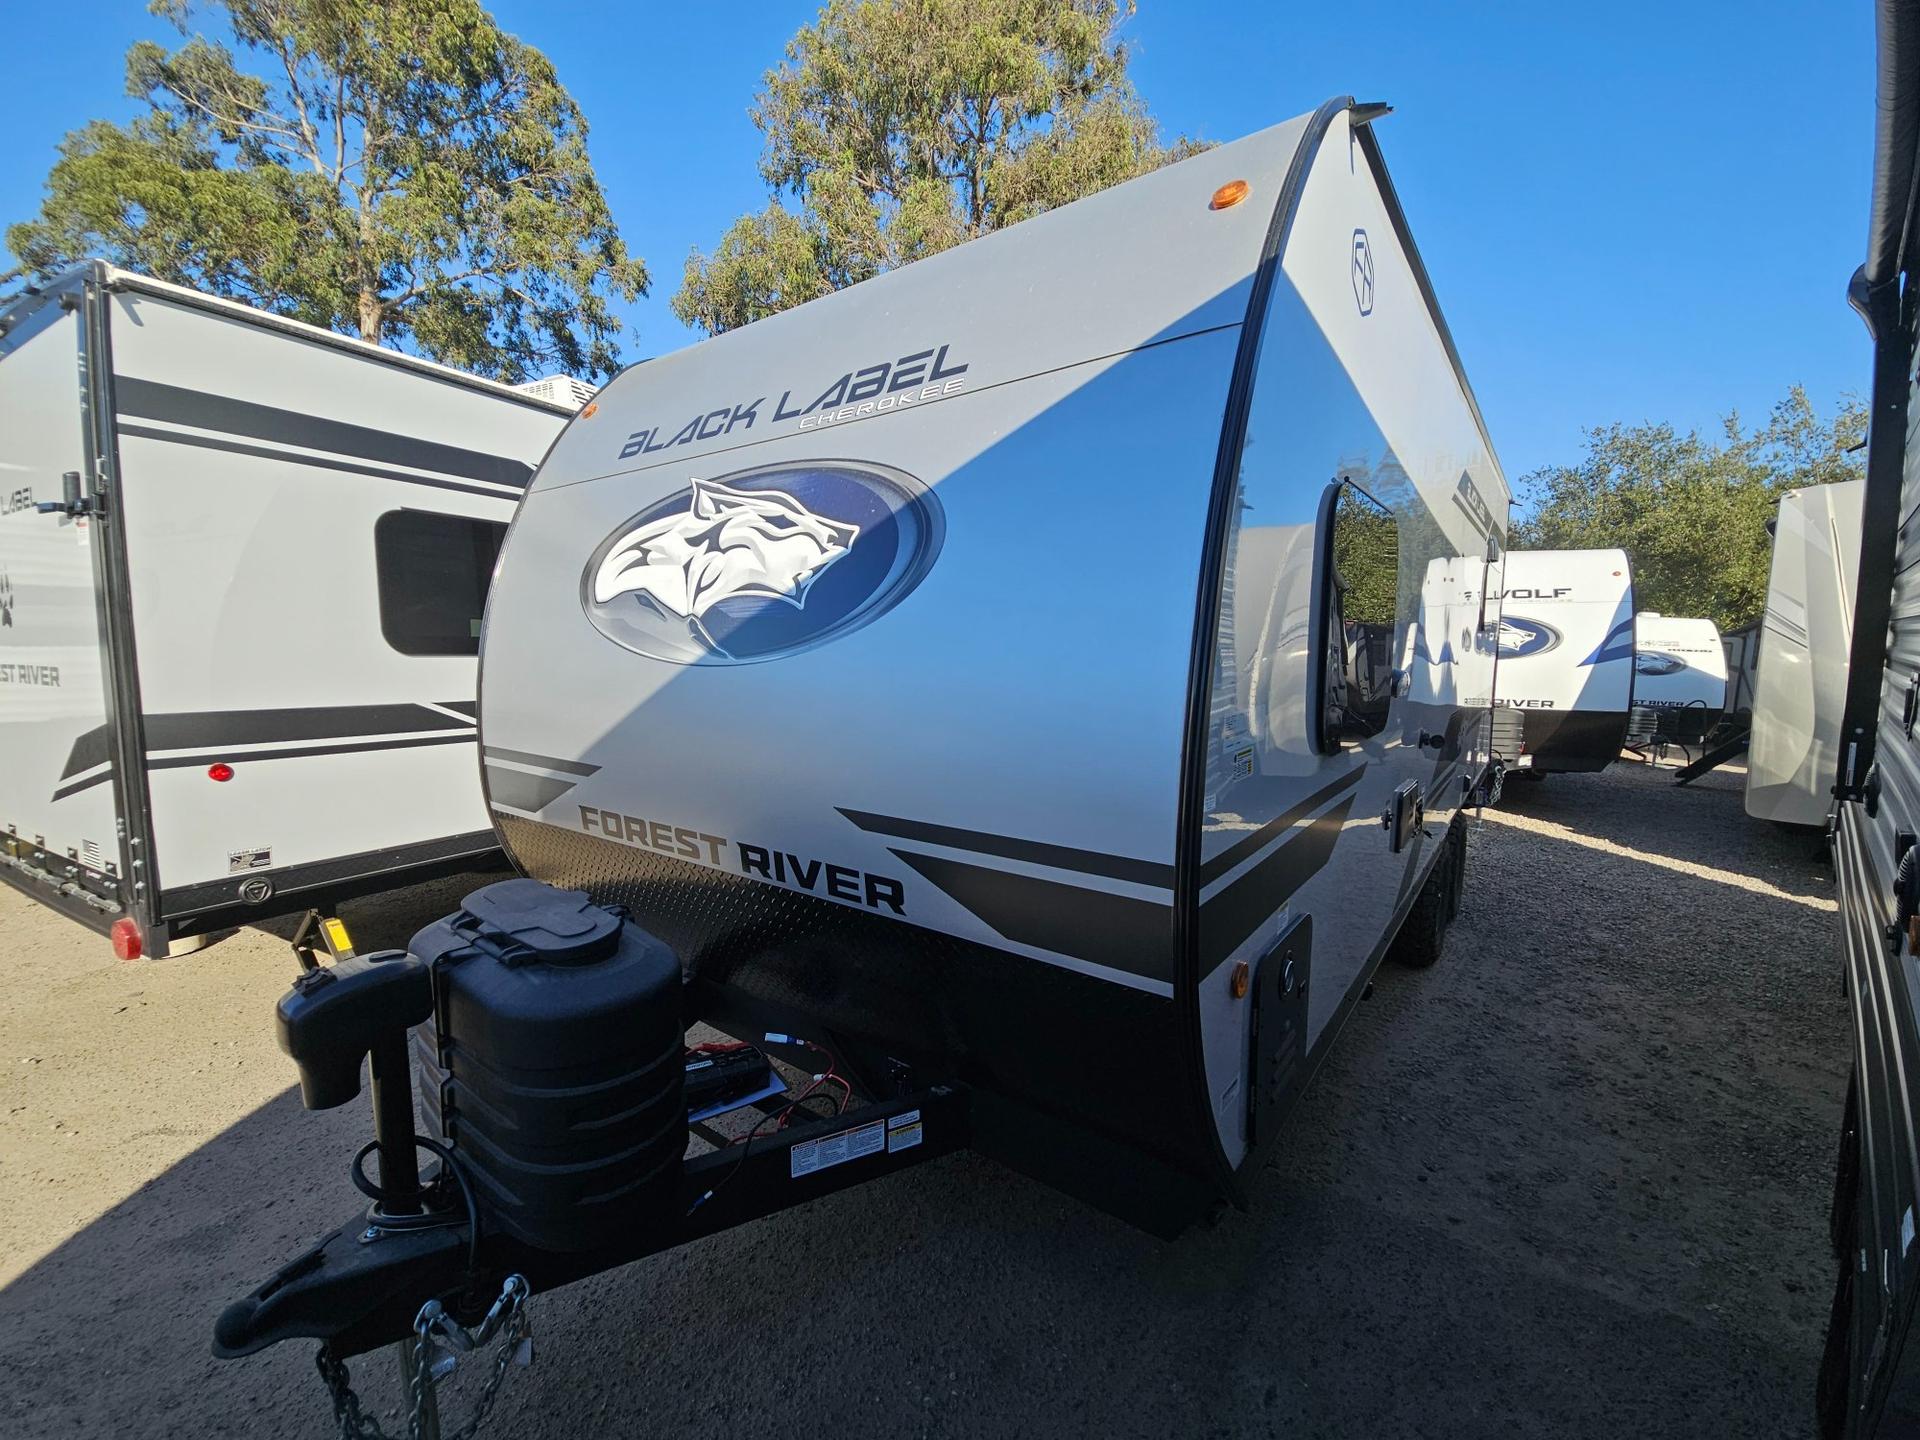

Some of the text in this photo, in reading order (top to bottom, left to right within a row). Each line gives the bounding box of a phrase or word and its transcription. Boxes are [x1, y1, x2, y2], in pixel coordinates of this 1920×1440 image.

[618, 344, 969, 459] BLACK LABEL
[799, 378, 965, 429] CHEROKEE
[0, 487, 35, 516] LABEL
[18, 664, 61, 687] RIVER
[579, 805, 907, 916] FOREST RIVER
